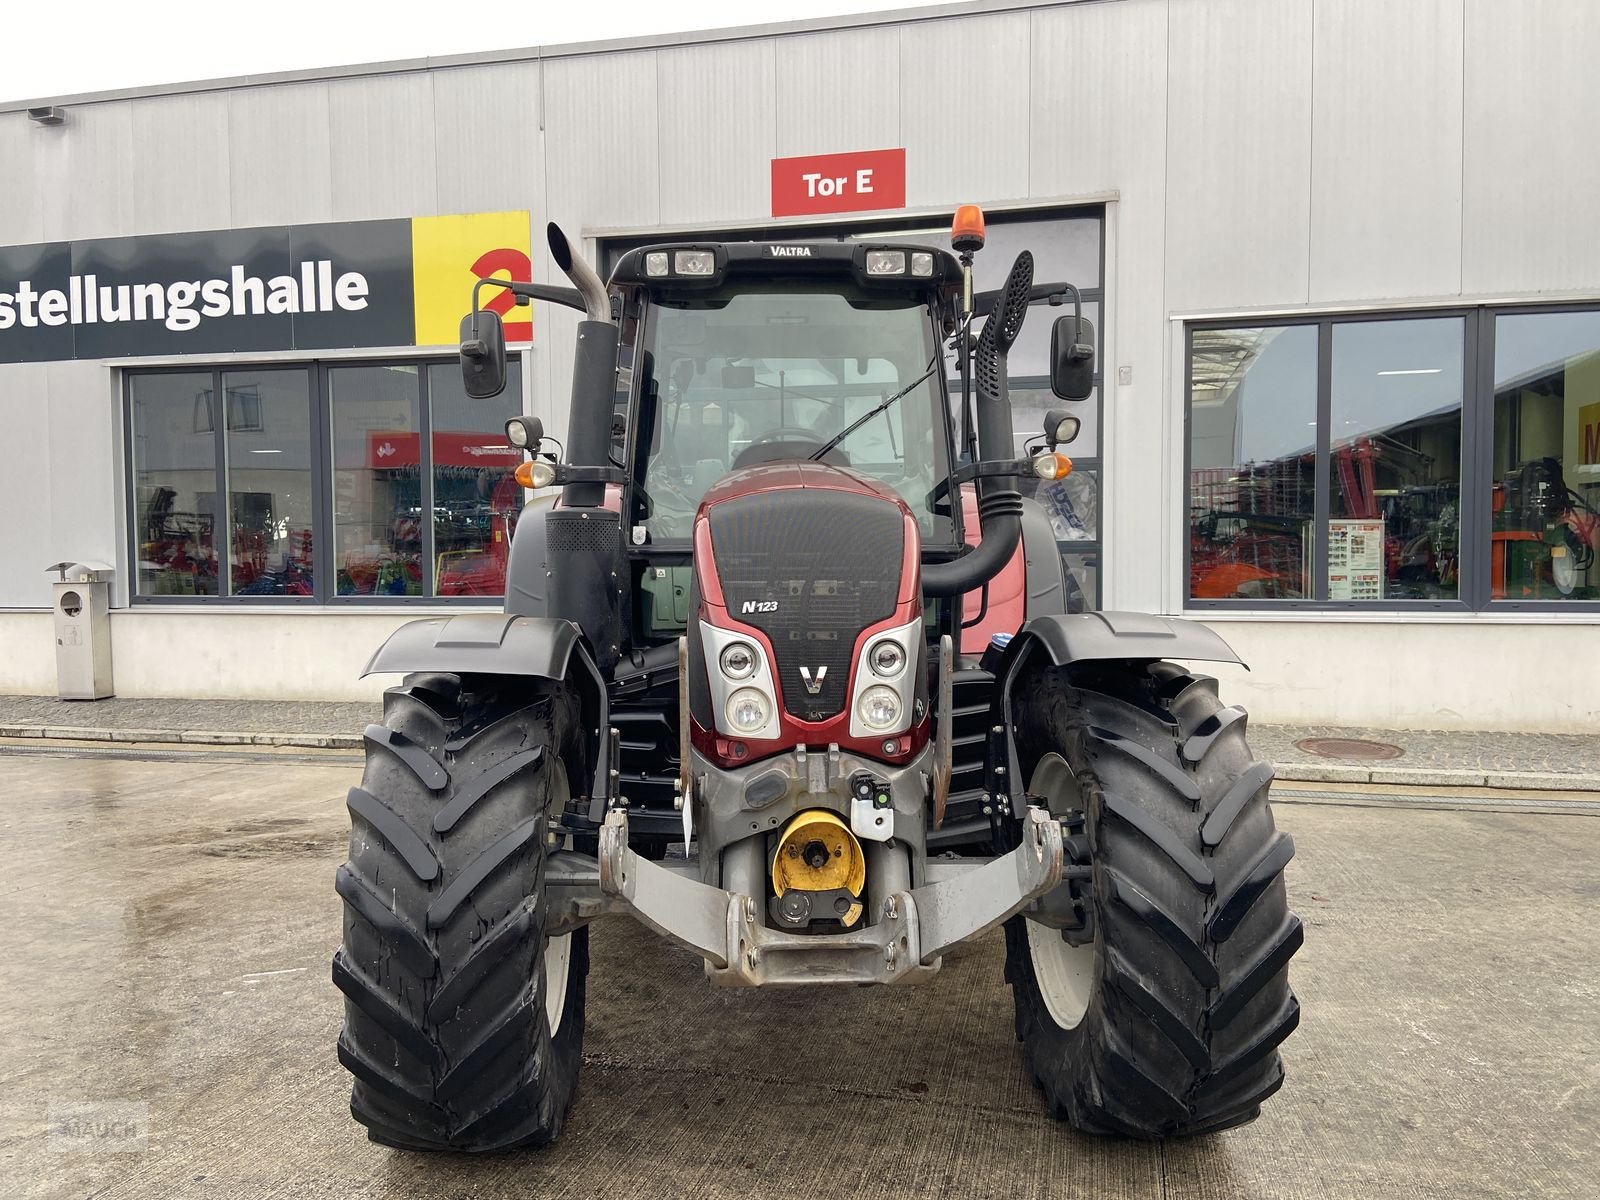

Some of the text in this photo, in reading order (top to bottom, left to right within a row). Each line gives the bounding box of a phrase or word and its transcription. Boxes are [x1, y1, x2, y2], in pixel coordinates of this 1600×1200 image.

[802, 169, 874, 198] Tor E
[770, 245, 812, 257] VALTRA
[469, 248, 533, 342] 2
